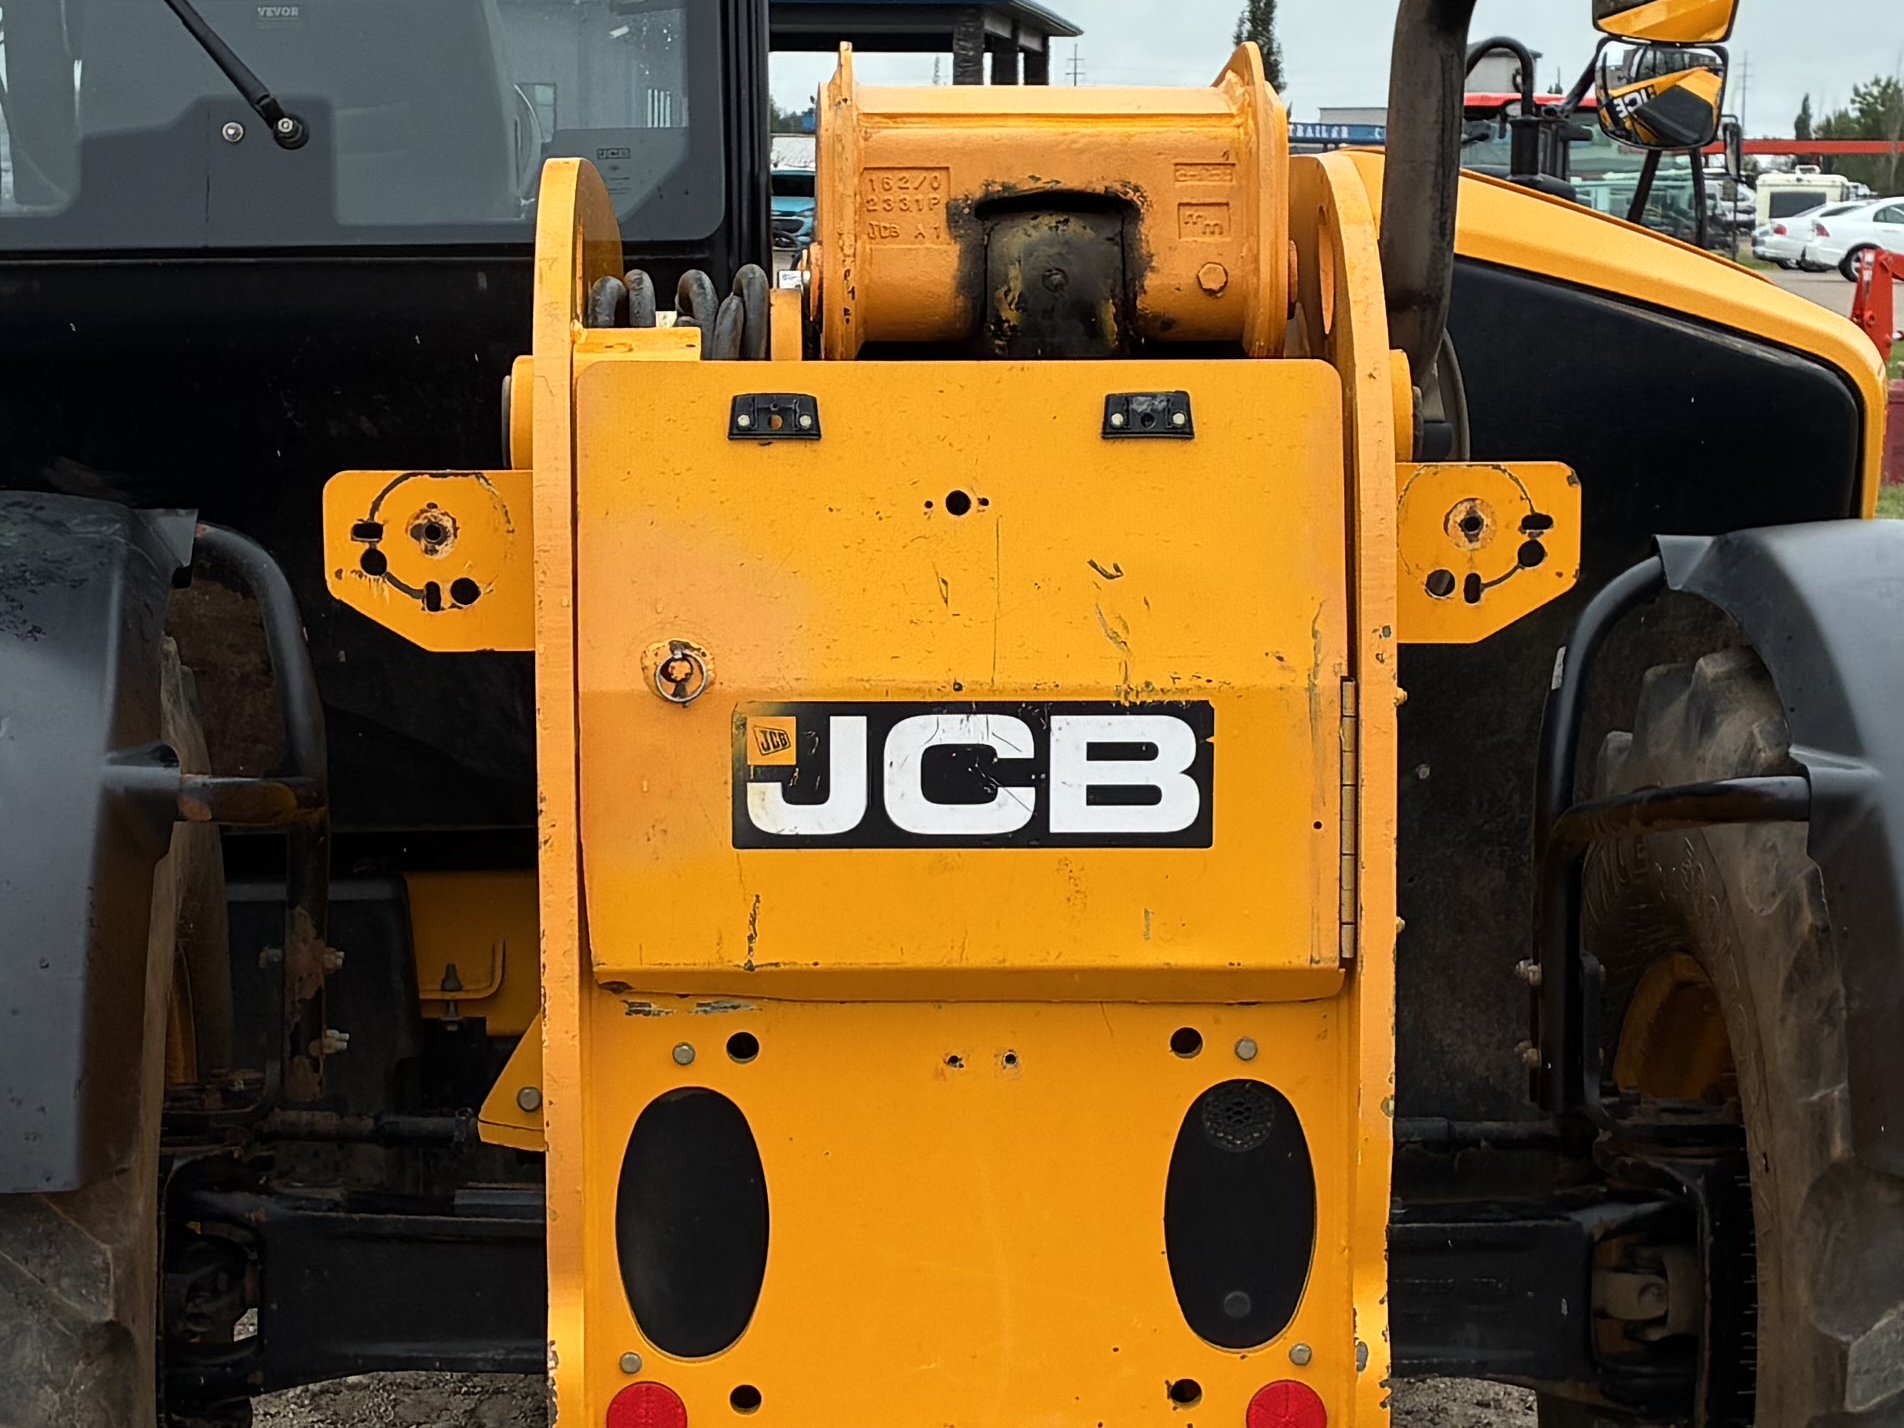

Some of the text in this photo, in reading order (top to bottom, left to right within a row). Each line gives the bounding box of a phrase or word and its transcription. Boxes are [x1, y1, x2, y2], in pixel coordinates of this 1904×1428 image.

[257, 6, 299, 17] VEVOR
[759, 728, 788, 752] JCB
[747, 713, 1200, 835] JCB
